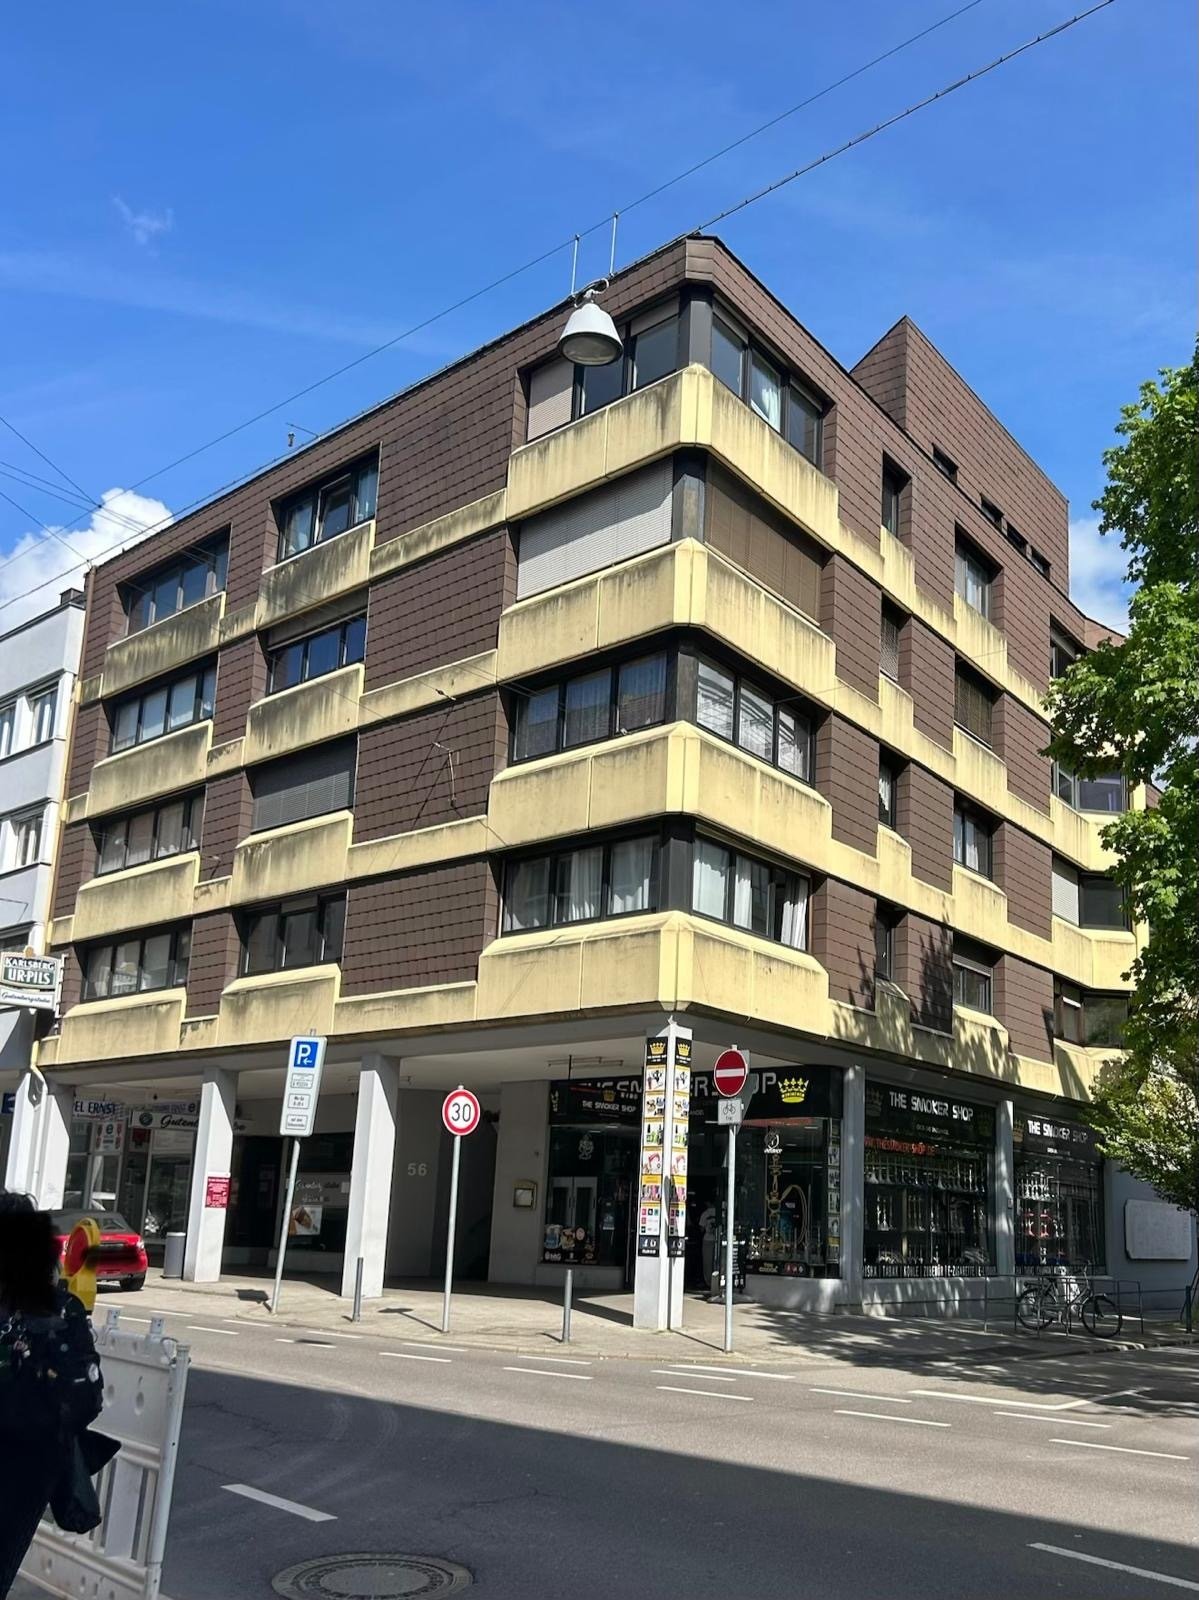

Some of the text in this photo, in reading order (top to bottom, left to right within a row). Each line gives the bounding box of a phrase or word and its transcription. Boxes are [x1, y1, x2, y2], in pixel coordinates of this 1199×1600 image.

[5, 957, 55, 970] KARLSBERG
[8, 968, 51, 985] UR-PILS
[451, 1103, 473, 1122] 30
[888, 1091, 974, 1121] THE SMOKER SHOP
[1027, 1120, 1041, 1136] THE
[1043, 1123, 1071, 1140] SMOKER
[407, 1162, 427, 1177] 56
